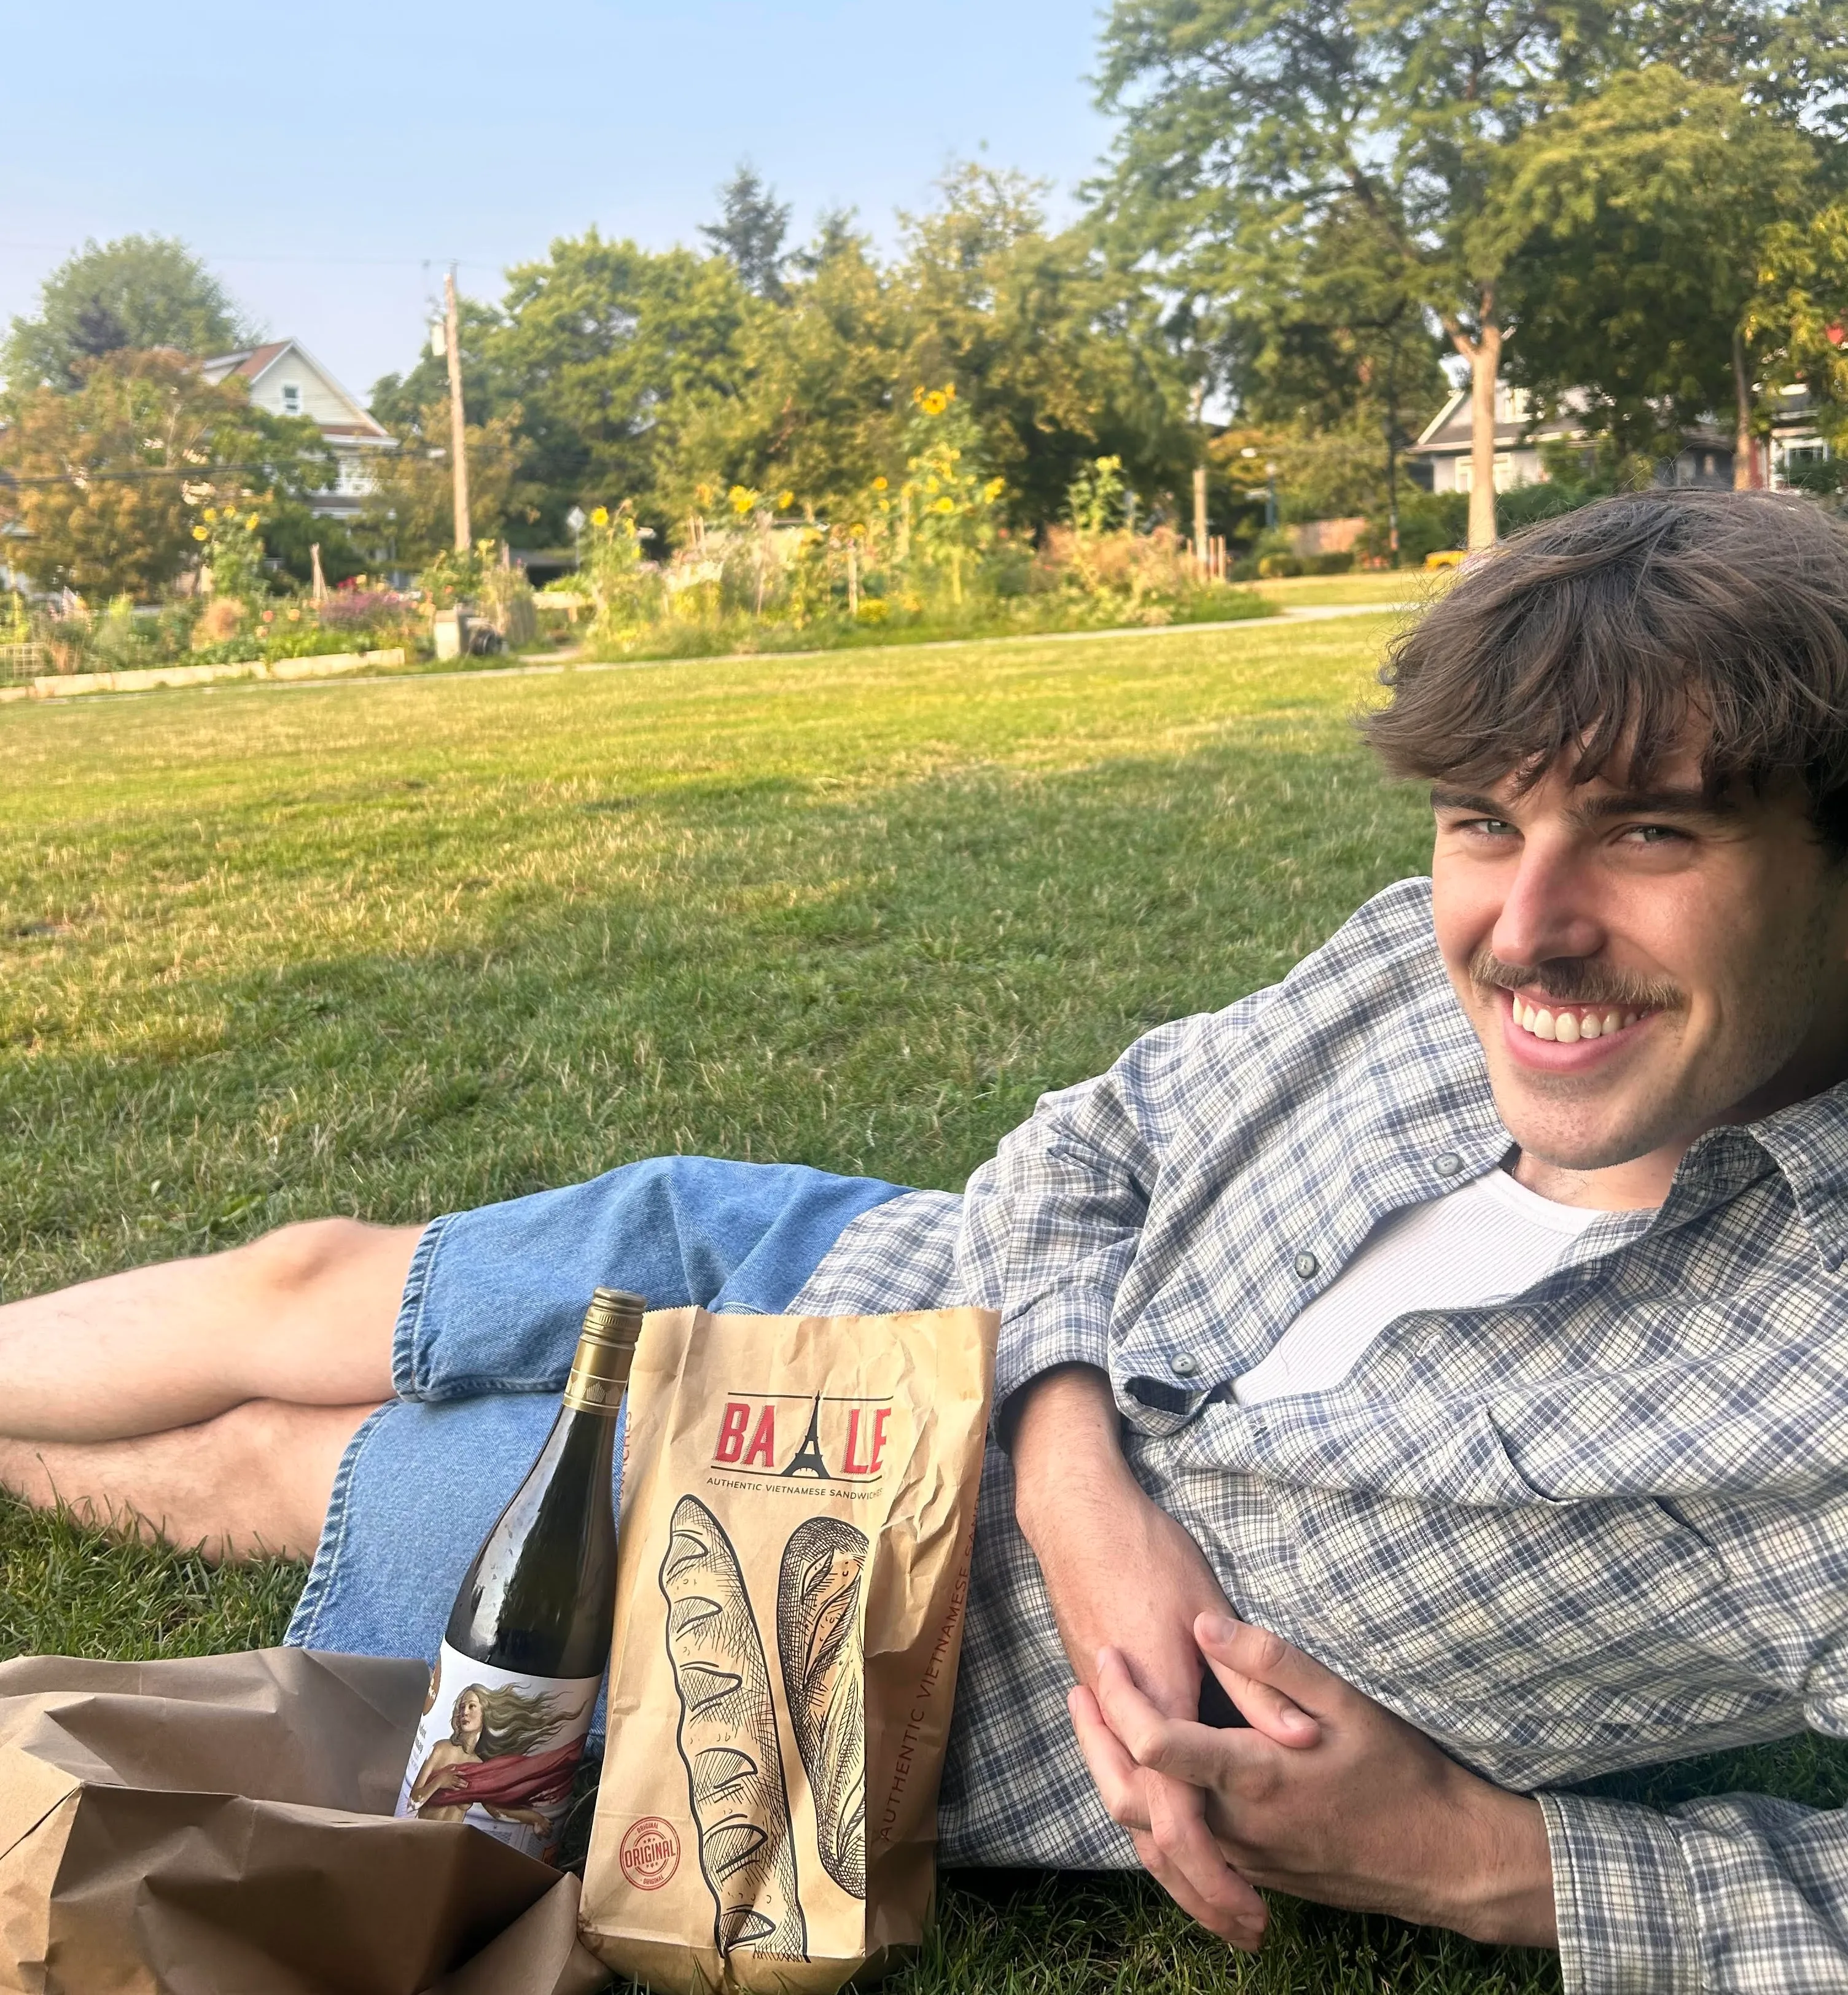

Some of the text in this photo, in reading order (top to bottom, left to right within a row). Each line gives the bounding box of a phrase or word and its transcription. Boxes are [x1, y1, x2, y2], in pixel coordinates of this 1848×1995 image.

[712, 1402, 892, 1475] BA LE
[706, 1477, 883, 1500] AUTHENTIC VIETNAMESE SANDWICHES
[879, 1566, 969, 1841] AUTHENTIC VIETNAMESE
[637, 1822, 658, 1833] ORIGINAL
[624, 1839, 676, 1868] ORIGINAL
[643, 1874, 664, 1884] ORIGINAL
